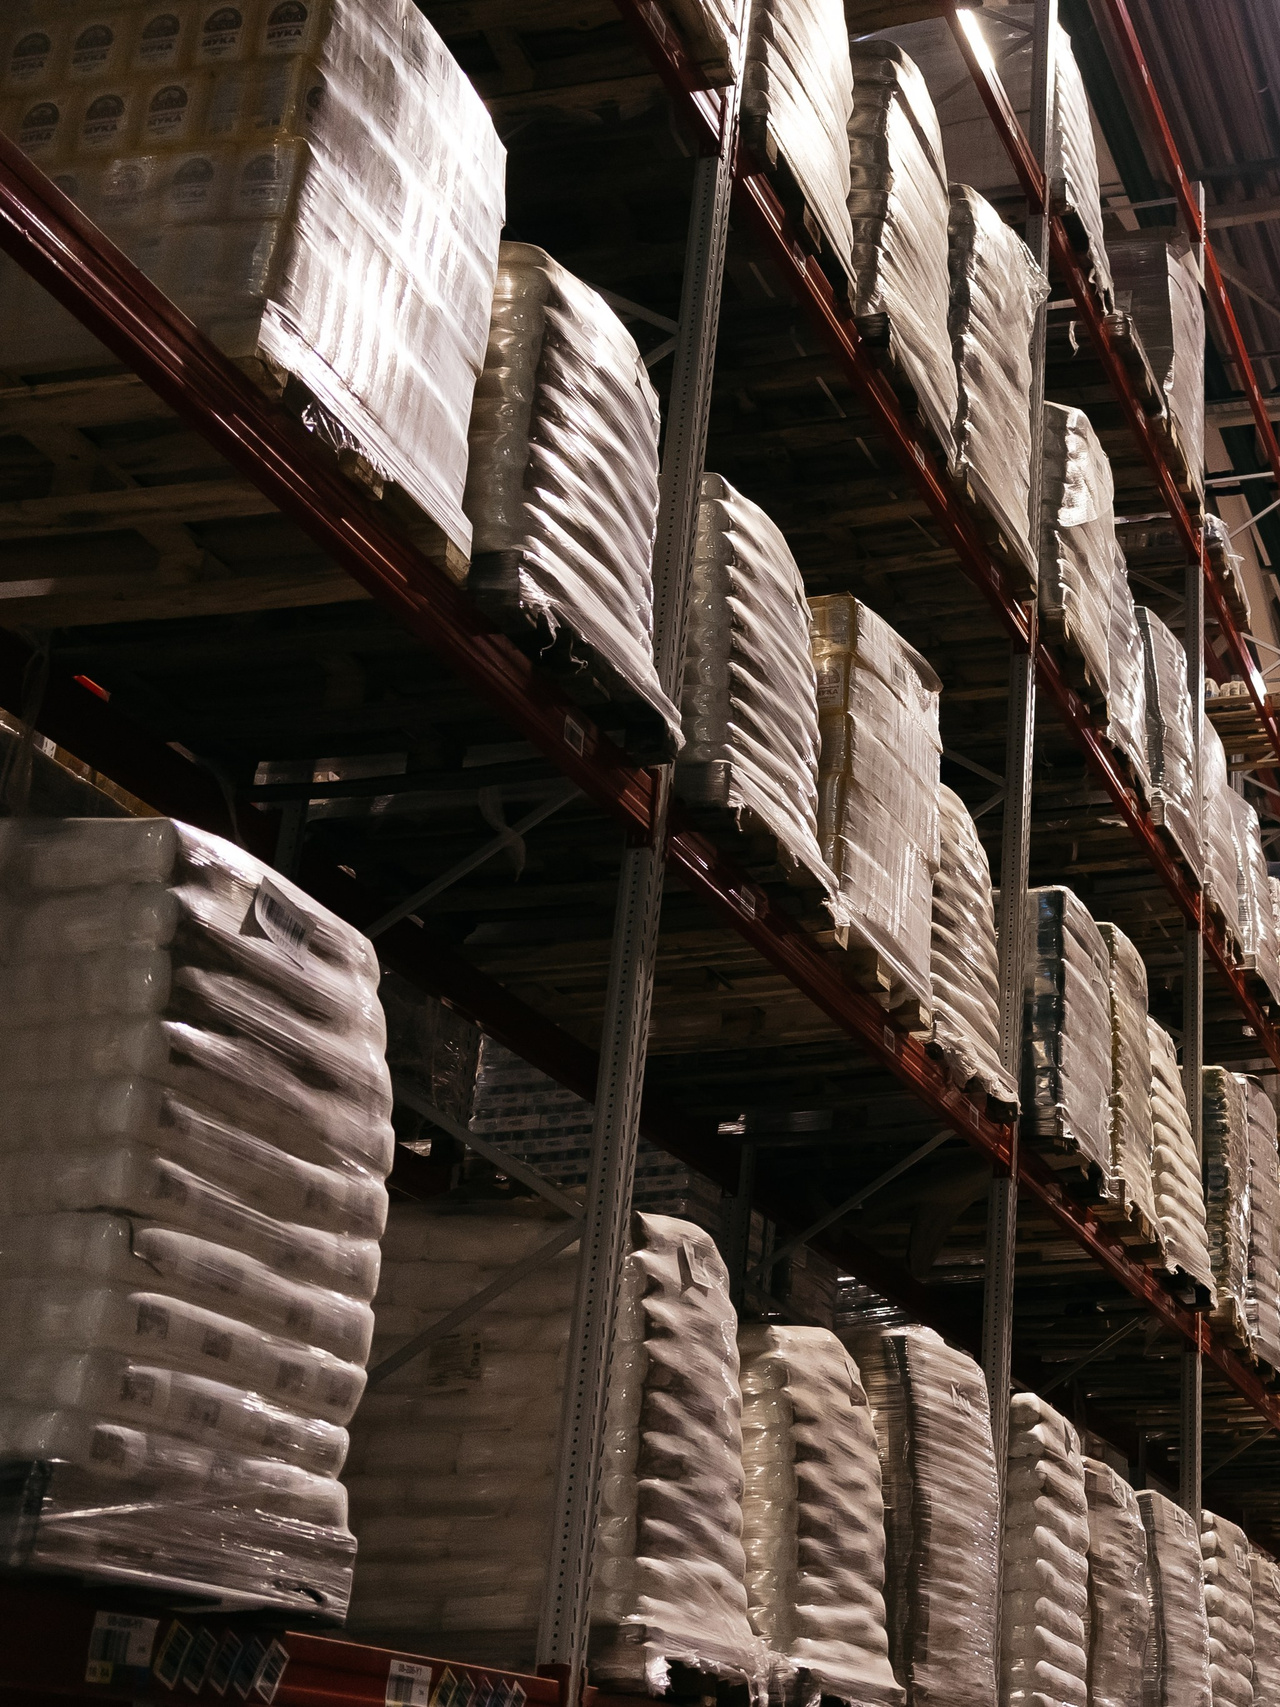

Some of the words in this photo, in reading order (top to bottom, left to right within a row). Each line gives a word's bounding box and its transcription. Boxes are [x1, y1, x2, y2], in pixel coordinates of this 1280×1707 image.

[267, 29, 302, 39] МУКА
[202, 36, 236, 47] МУКА
[147, 114, 182, 126] МУКА
[83, 124, 118, 134] МУКА
